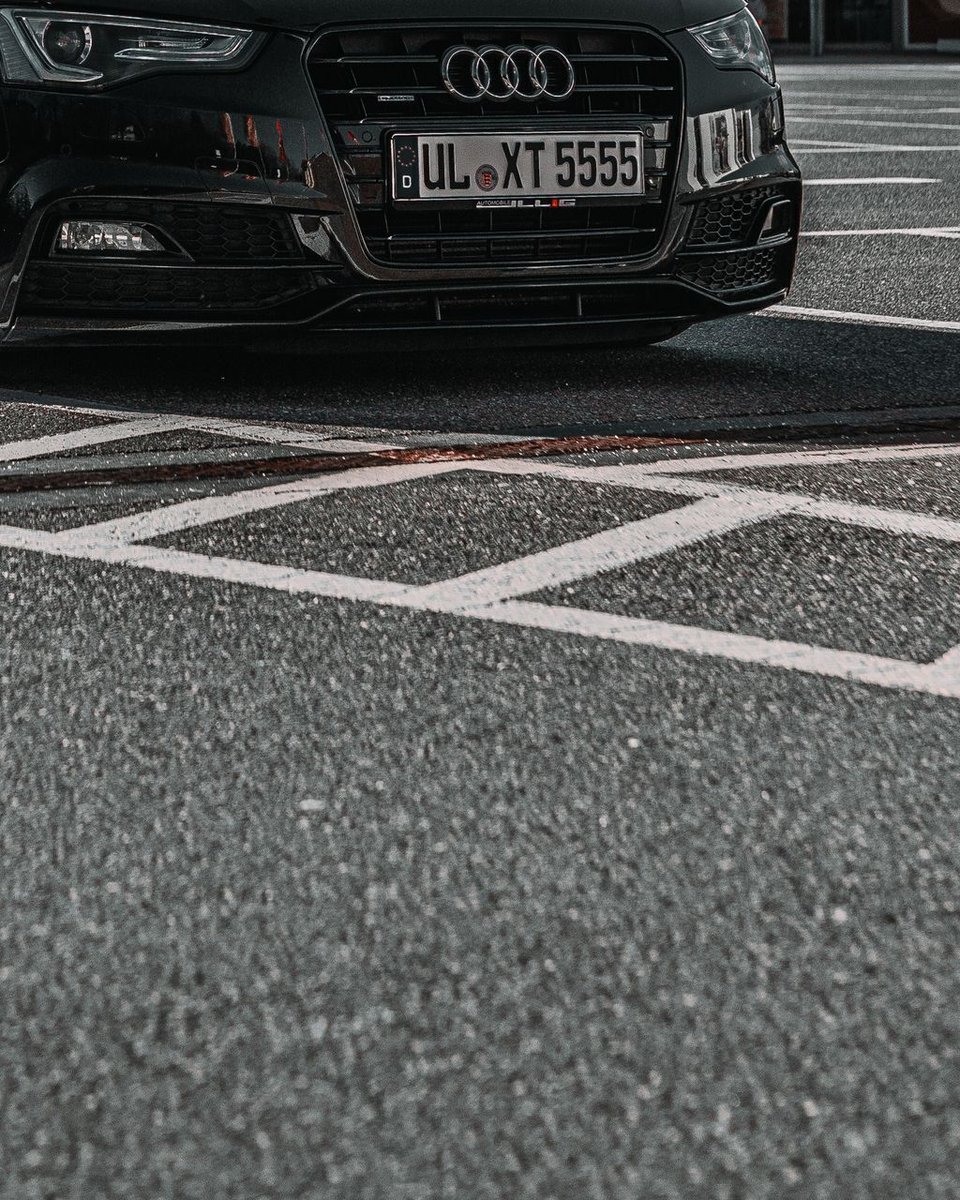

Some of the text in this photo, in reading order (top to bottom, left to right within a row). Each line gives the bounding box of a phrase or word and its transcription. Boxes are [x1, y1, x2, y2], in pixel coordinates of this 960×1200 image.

[422, 141, 638, 190] UL XT 5555
[402, 175, 412, 188] D
